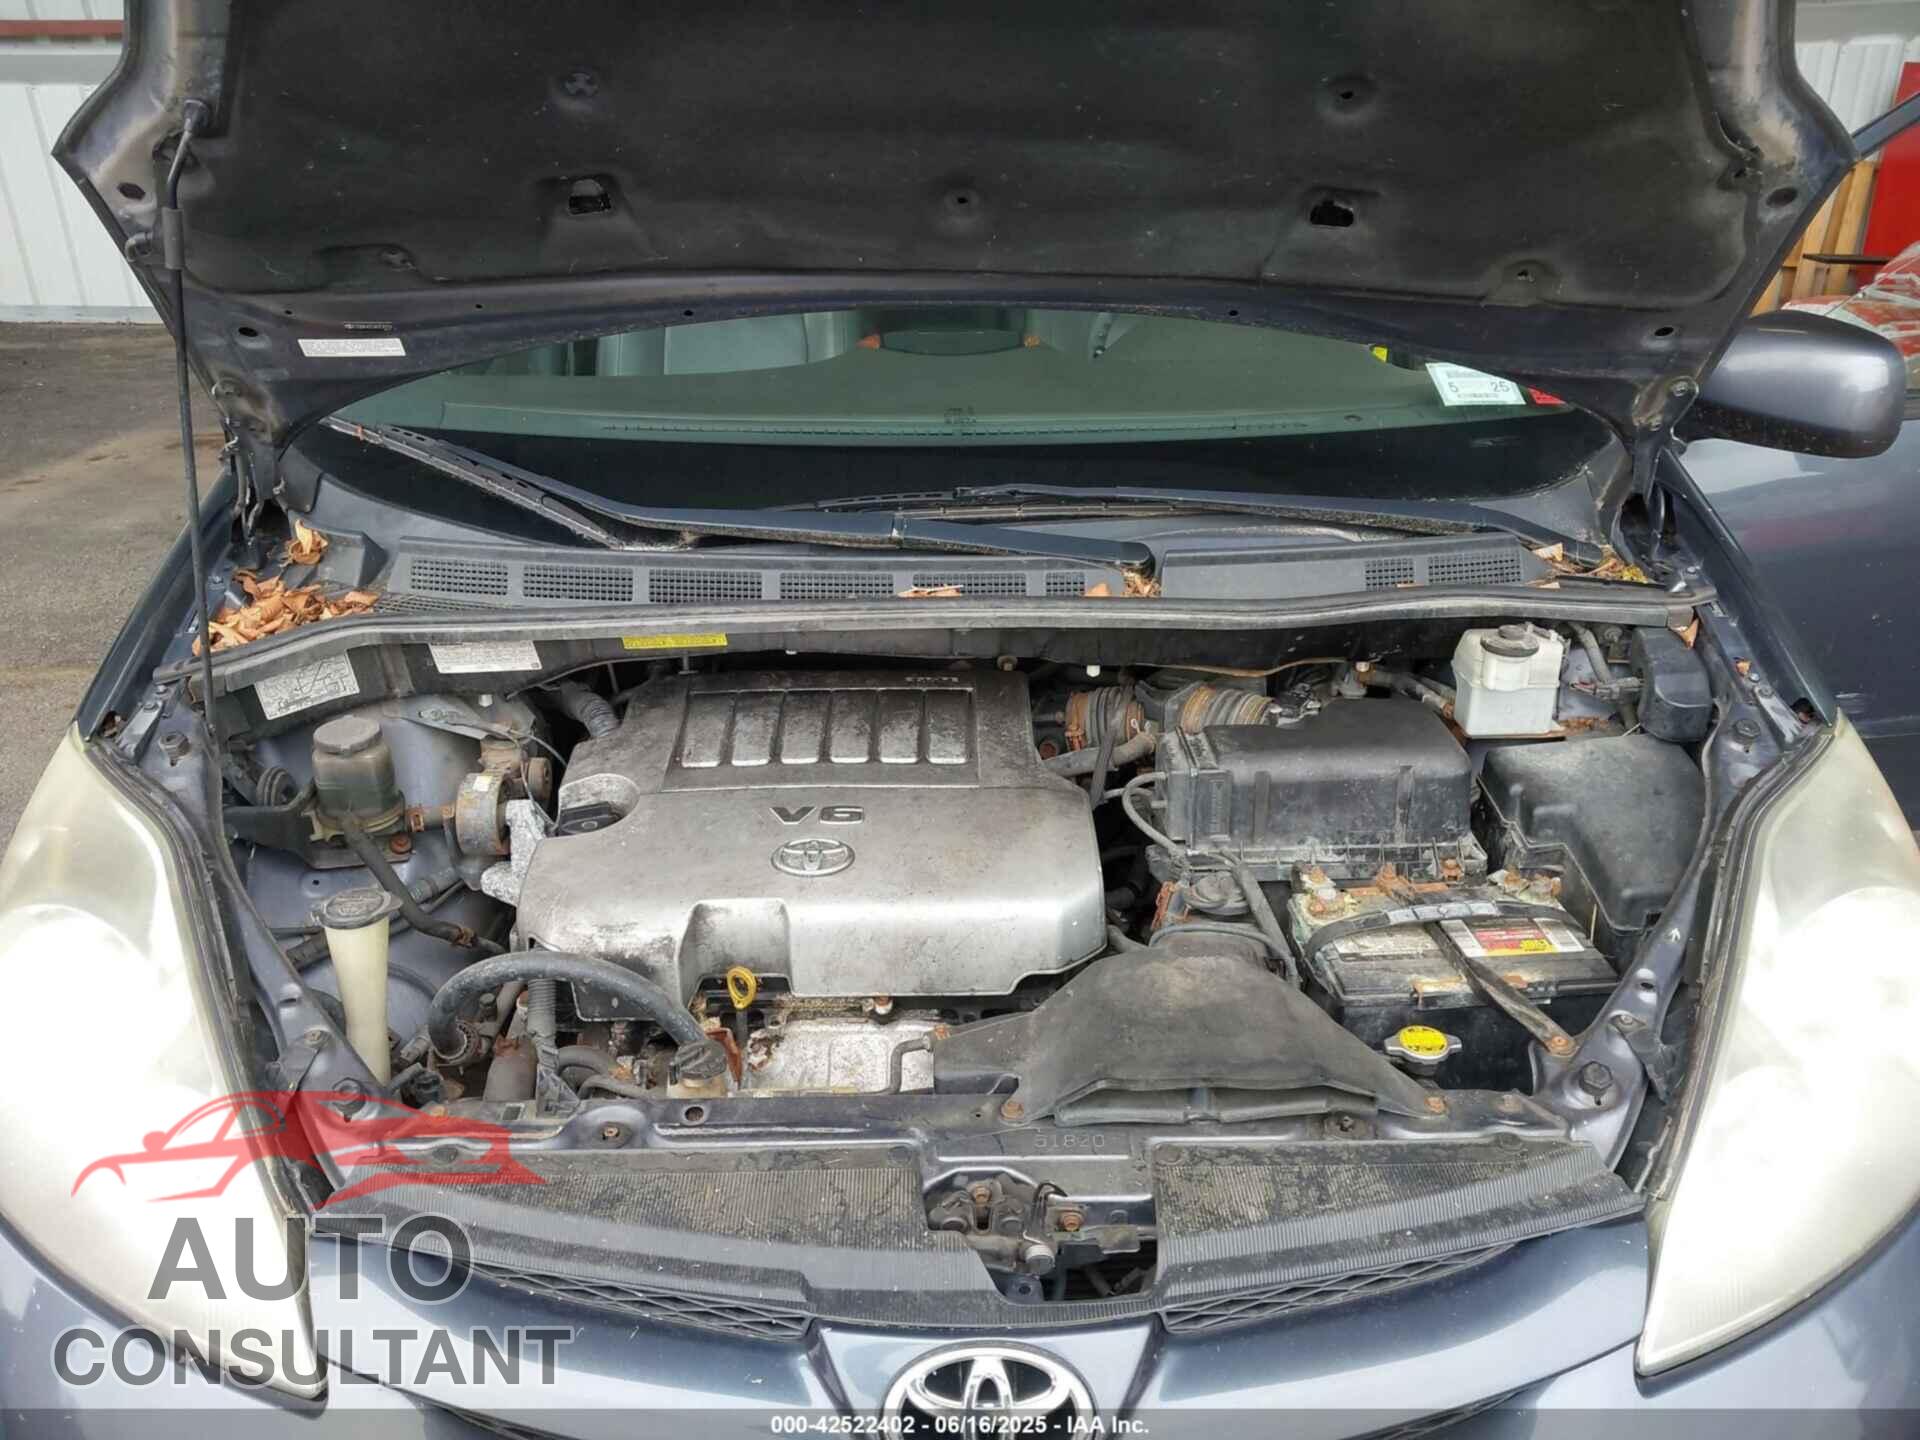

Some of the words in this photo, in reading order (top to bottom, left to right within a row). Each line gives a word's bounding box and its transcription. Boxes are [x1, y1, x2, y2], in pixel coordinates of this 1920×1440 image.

[1448, 381, 1458, 393] 5
[1490, 381, 1510, 393] 25
[769, 805, 864, 824] V6
